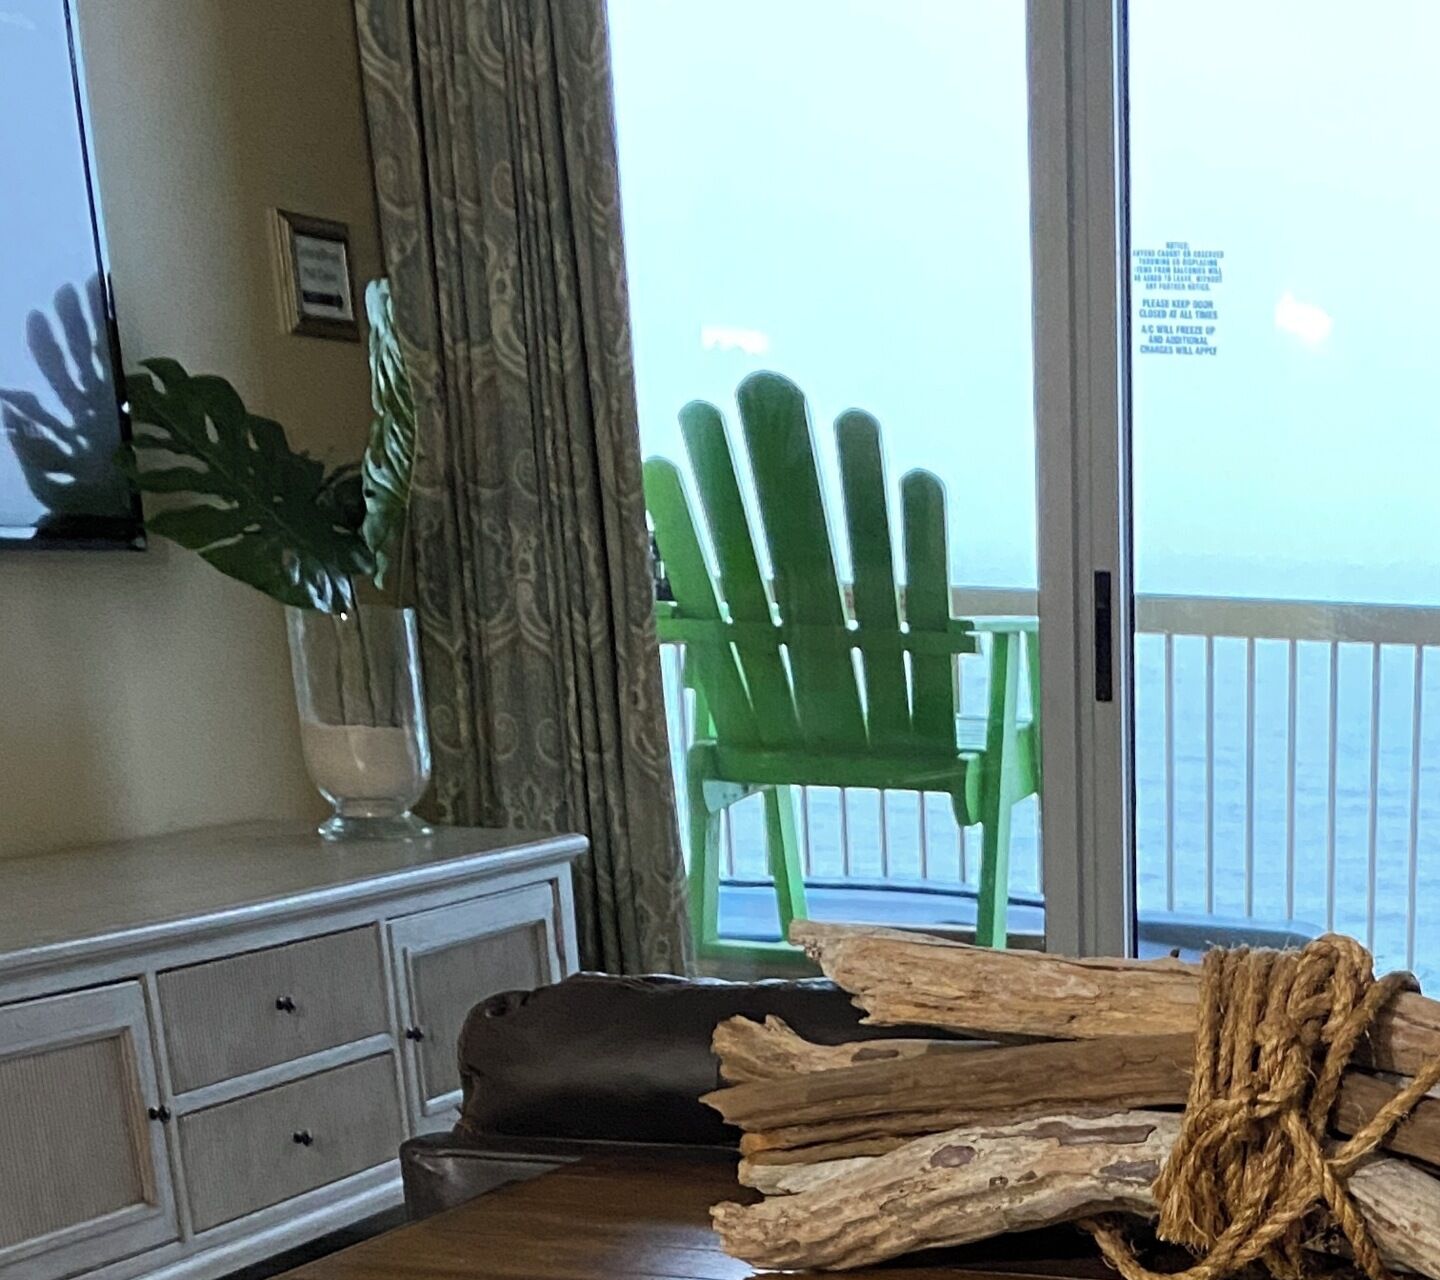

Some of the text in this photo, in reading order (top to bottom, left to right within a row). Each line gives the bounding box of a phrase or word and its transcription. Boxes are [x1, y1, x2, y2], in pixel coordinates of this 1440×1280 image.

[1142, 299, 1213, 308] PLEASE KEEP DOOR
[1139, 309, 1218, 319] CLOSED AT ALL TIMES
[1156, 325, 1215, 335] WILL FREEZE UP
[1149, 335, 1208, 345] AND ADDITIONAL
[1140, 345, 1217, 355] CHARGES WILL APPLY
